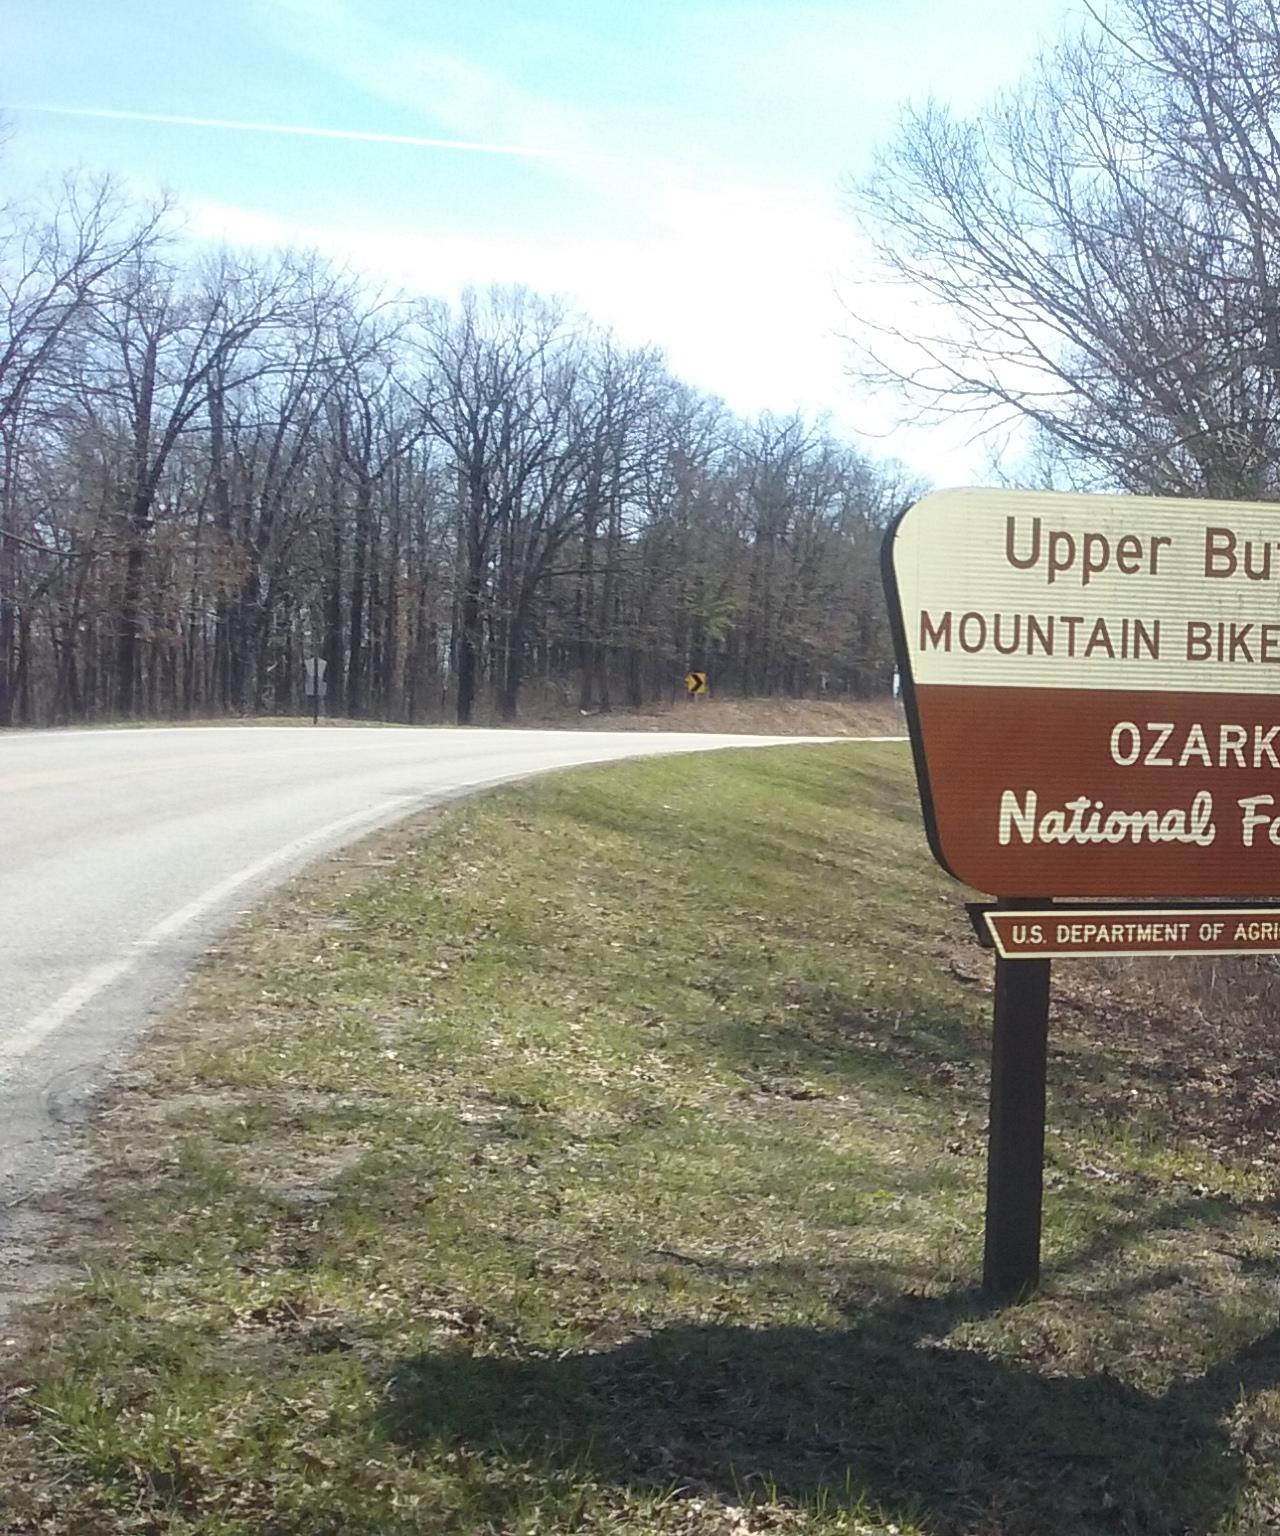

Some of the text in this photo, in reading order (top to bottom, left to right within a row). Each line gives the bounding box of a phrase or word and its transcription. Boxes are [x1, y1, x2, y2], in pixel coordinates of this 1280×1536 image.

[1005, 516, 1172, 586] Upper
[920, 610, 1161, 660] MOUNTAIN
[998, 790, 1216, 846] National
[1012, 924, 1047, 944] U.S.
[1056, 922, 1190, 943] DEPARTMENT
[1199, 922, 1223, 941] OF
